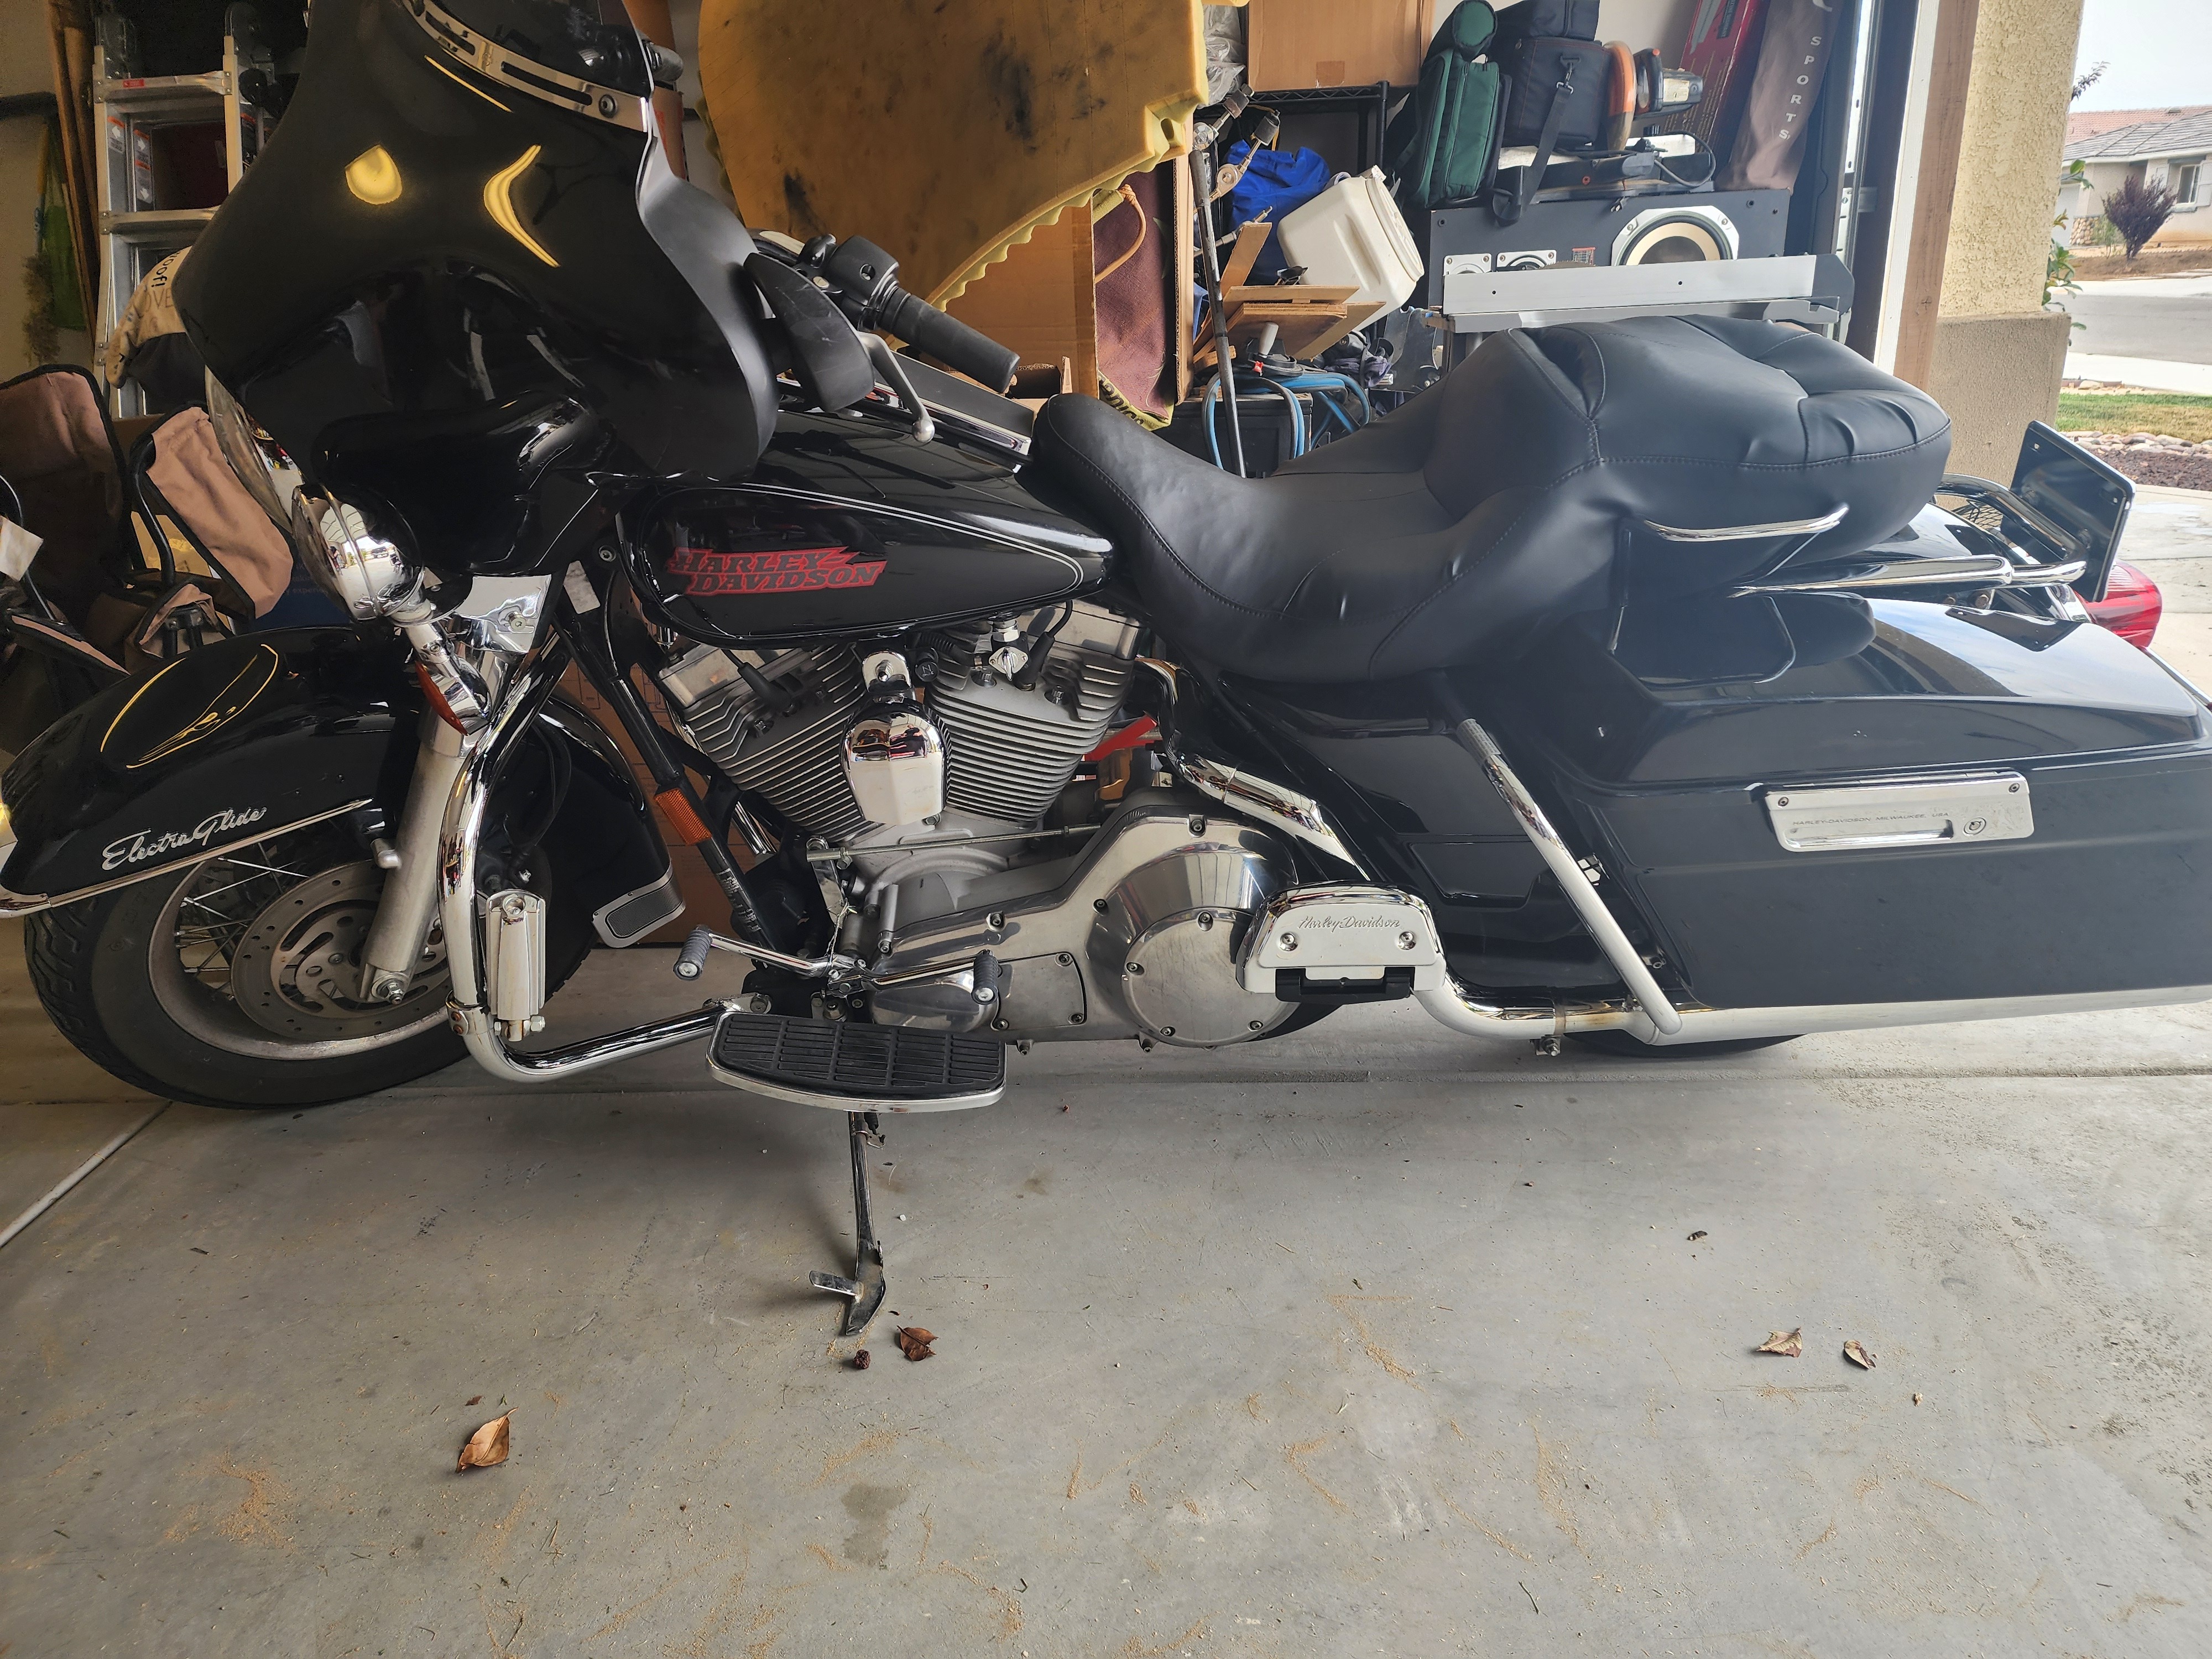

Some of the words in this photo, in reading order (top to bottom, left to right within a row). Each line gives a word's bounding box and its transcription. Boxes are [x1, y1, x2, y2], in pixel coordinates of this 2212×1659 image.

[1778, 35, 1822, 140] SPORTS
[668, 547, 851, 573] HARLEY
[688, 562, 885, 594] DAVIDSON
[1792, 817, 1871, 825] HARLEY-DAVIDSON
[1297, 915, 1401, 933] Harley-Davidson
